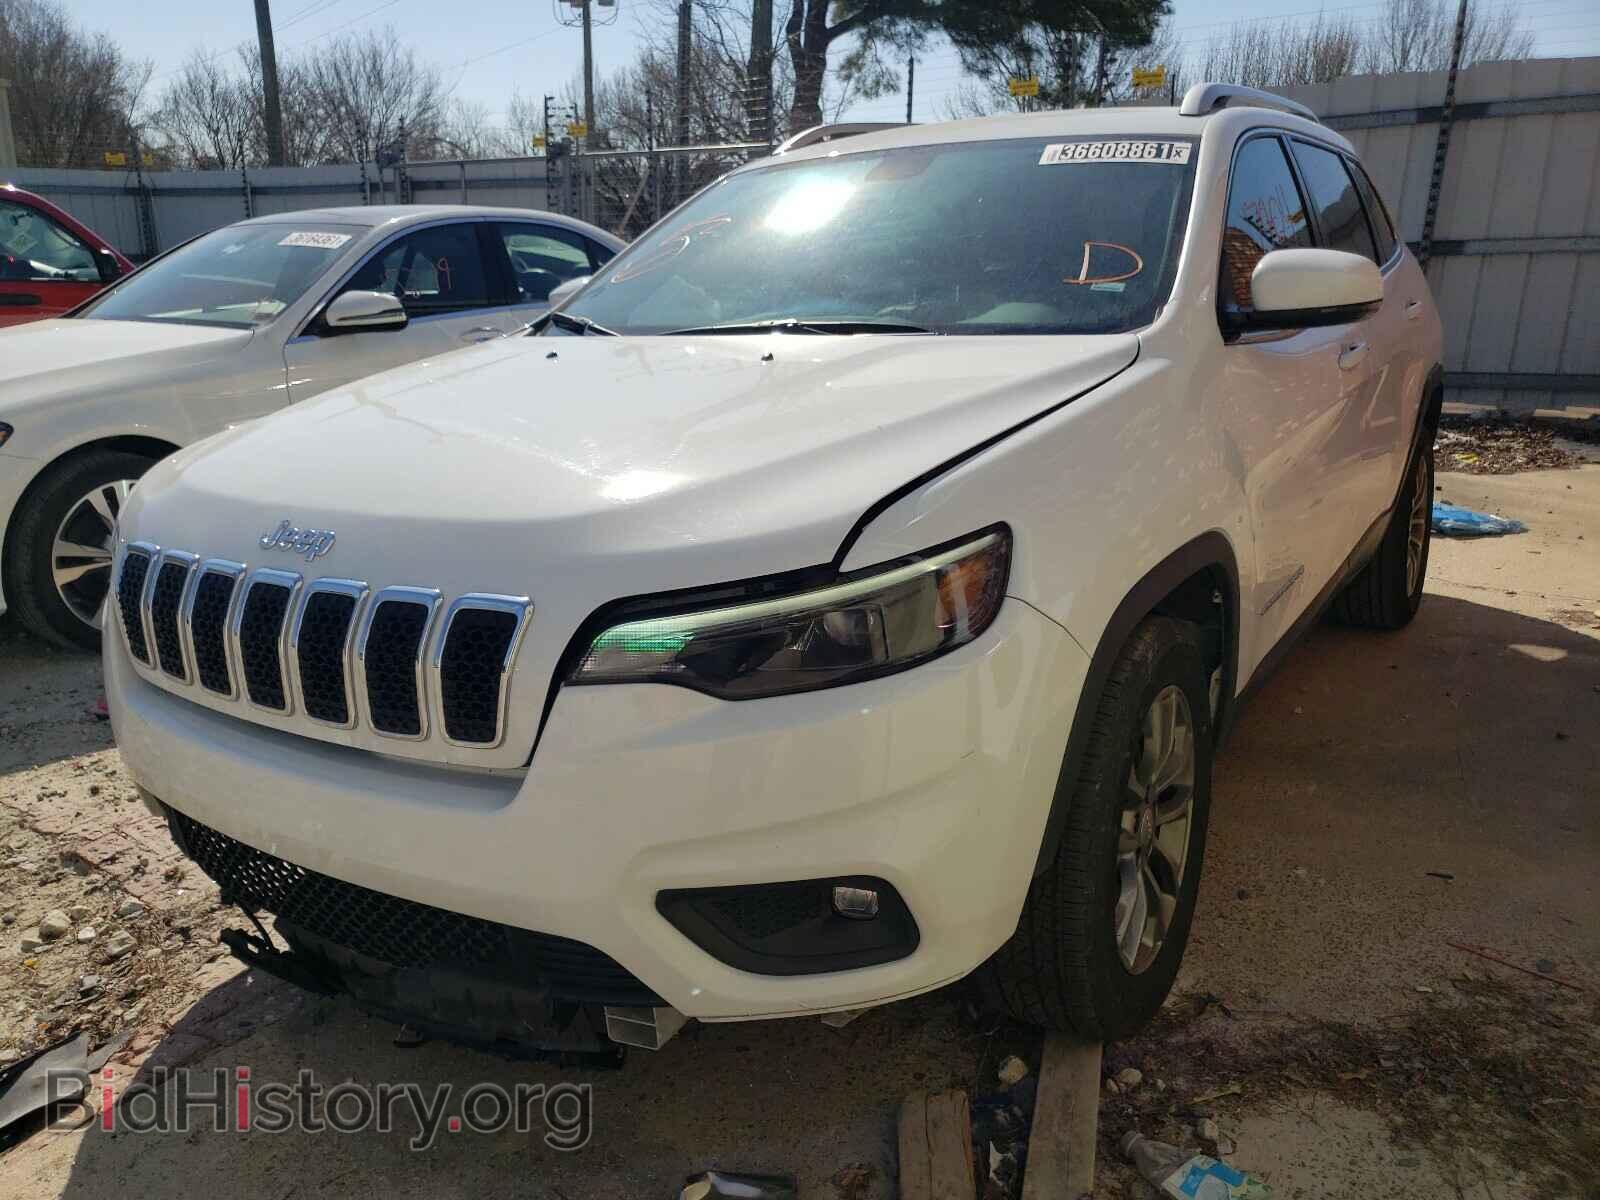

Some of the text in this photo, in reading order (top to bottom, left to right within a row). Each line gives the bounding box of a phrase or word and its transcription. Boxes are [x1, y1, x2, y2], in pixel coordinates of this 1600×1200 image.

[1060, 142, 1170, 160] 36608861
[1063, 240, 1143, 284] D
[259, 519, 336, 562] Jeep
